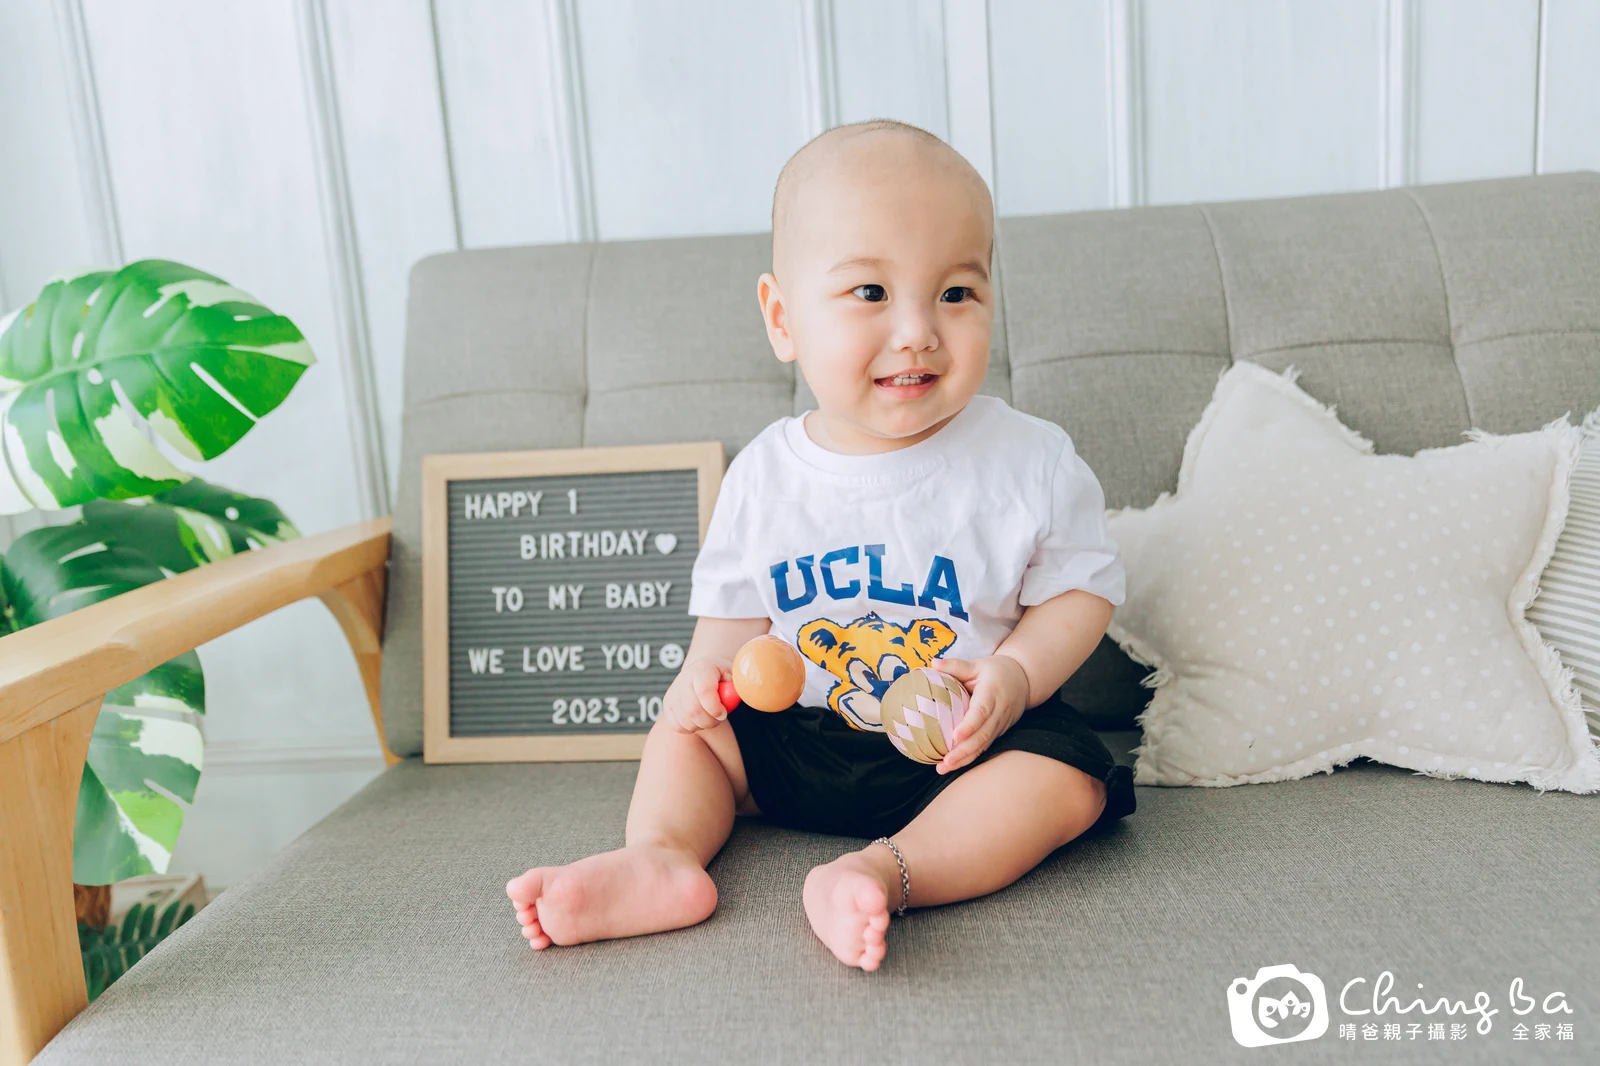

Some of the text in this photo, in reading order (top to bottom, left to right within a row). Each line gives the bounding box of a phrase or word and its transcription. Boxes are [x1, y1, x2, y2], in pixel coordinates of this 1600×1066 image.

[464, 488, 577, 520] HAPPY 1
[520, 529, 648, 560] BIRTHDAY
[491, 580, 673, 613] TO MY BABY
[769, 543, 969, 623] UCLA
[468, 644, 650, 675] WE LOVE YOU
